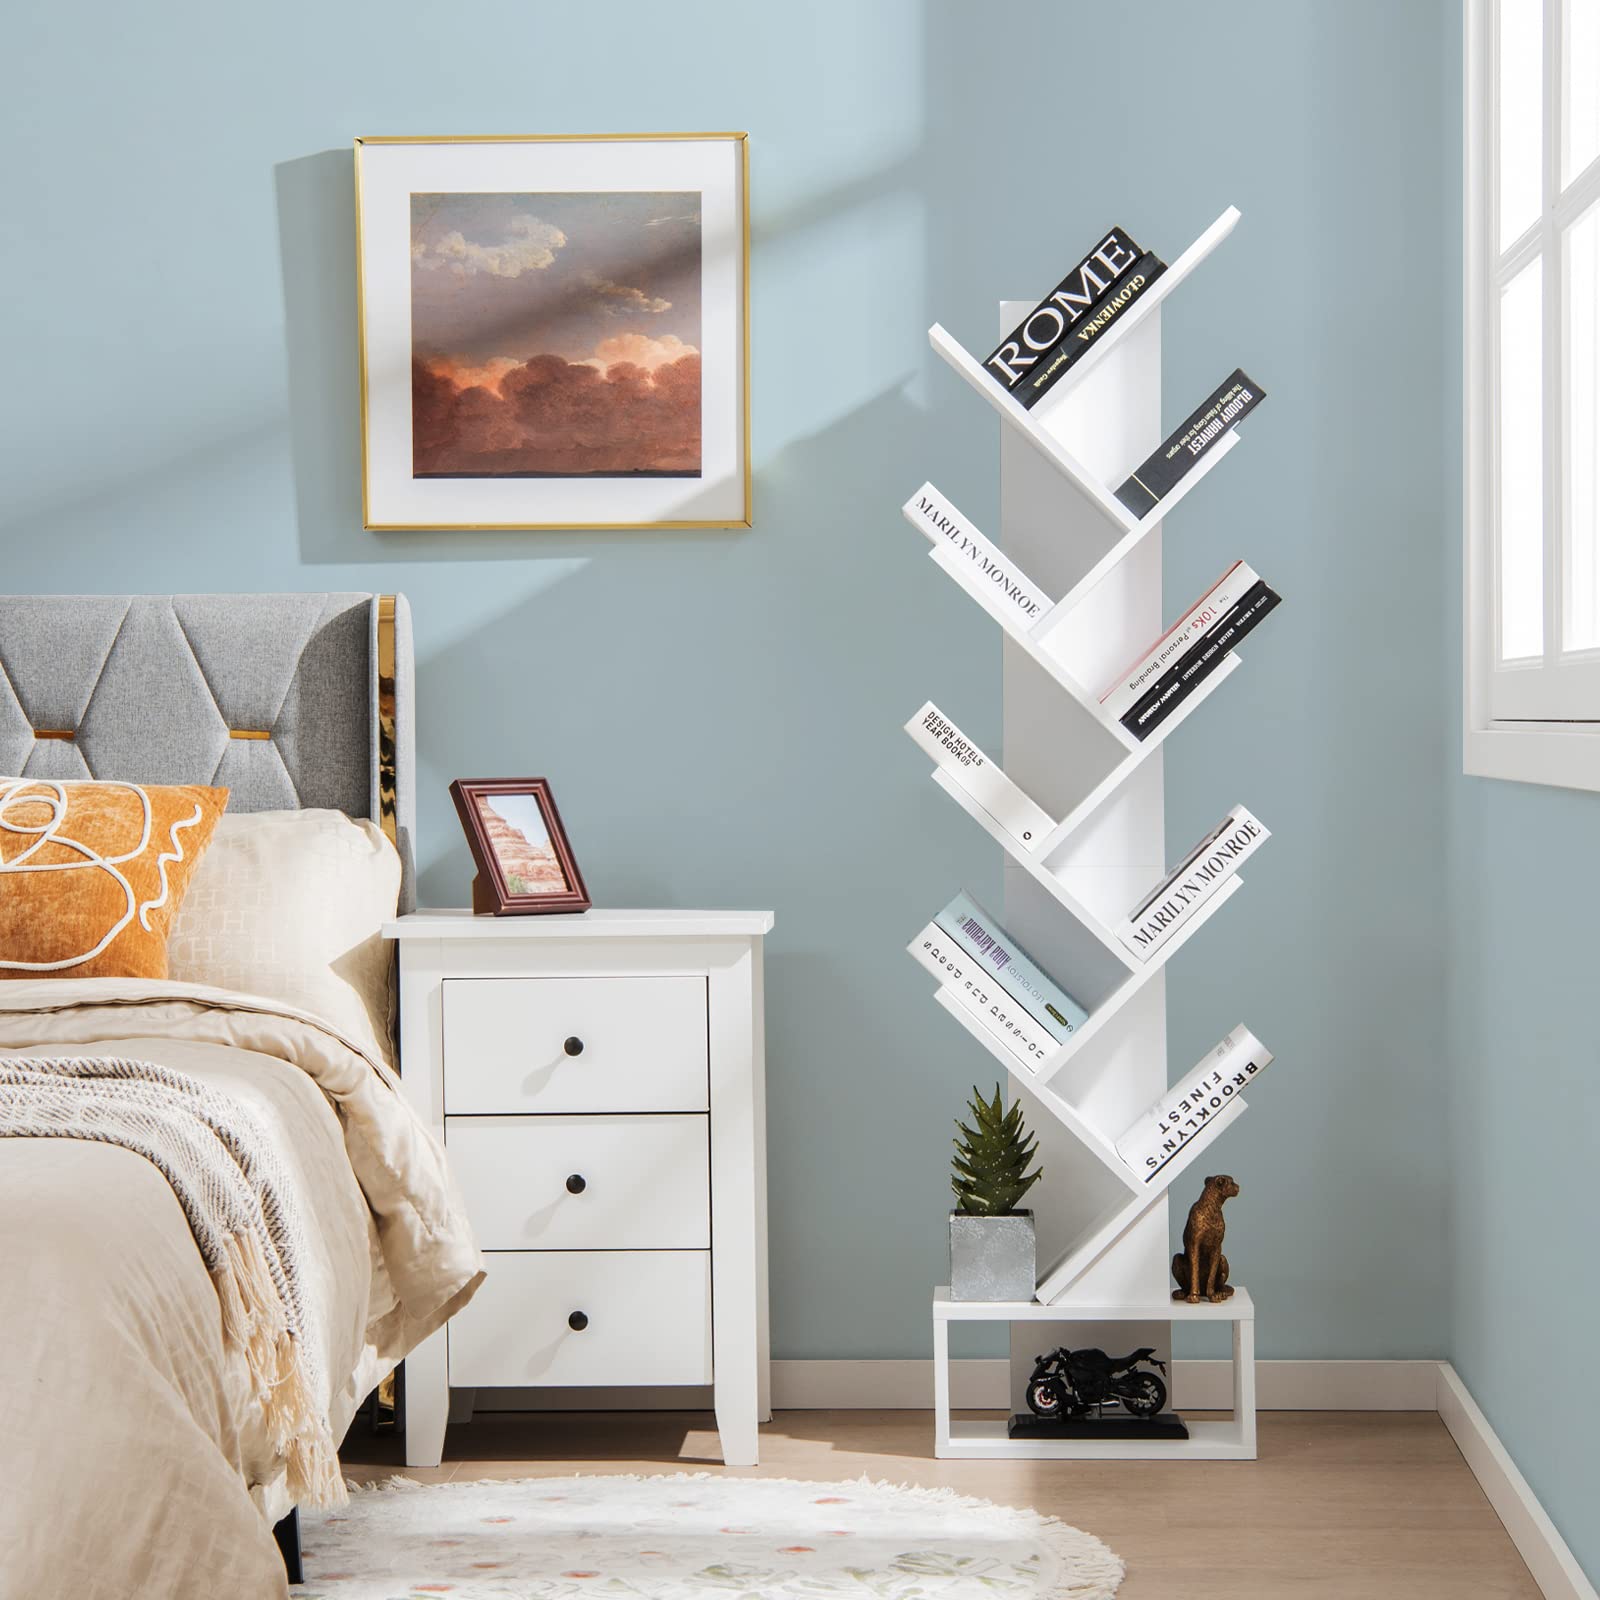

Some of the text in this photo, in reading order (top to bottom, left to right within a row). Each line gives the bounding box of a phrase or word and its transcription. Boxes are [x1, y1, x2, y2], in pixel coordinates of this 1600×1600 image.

[988, 235, 1136, 386] ROME
[1231, 383, 1243, 394] The
[1188, 389, 1253, 455] BLOODY HARVEST
[1215, 403, 1222, 412] of
[916, 497, 1040, 618] MARILYN MONROE
[1191, 606, 1217, 629] 10Ks
[1158, 633, 1189, 664] Personal
[1129, 661, 1160, 690] Branding
[922, 717, 942, 739] YEAR
[927, 711, 984, 766] DESIGN HOTELS
[1133, 820, 1261, 949] MARILYN MONROE
[961, 918, 996, 955] Karenina
[989, 945, 1012, 970] Anna
[1006, 963, 1036, 992] TOLSTOY
[923, 941, 962, 979] speed
[964, 981, 988, 1004] and
[990, 1006, 1045, 1059] passion
[1146, 1061, 1259, 1168] BROOKLYN'S
[1159, 1071, 1222, 1135] FINEST
